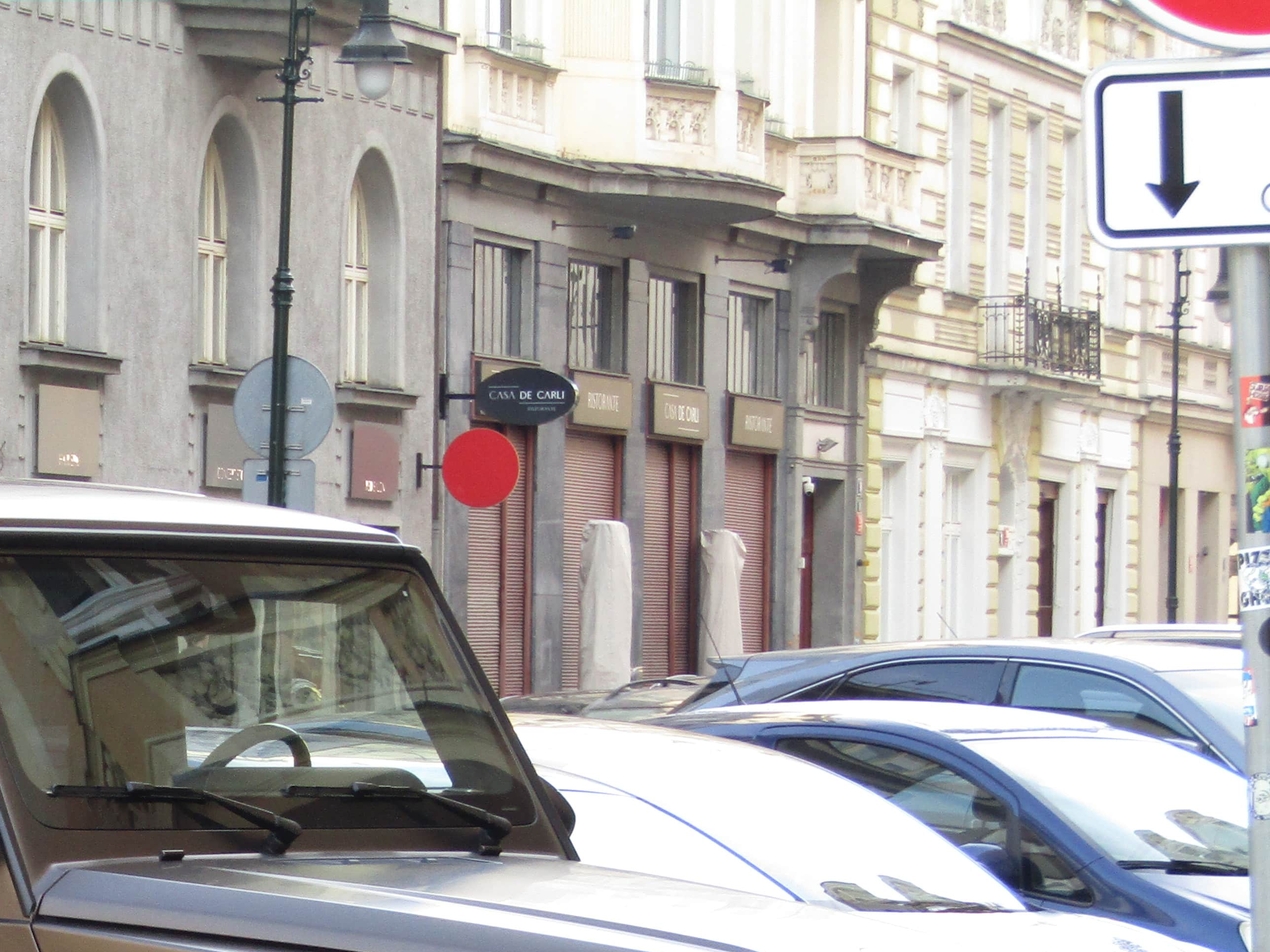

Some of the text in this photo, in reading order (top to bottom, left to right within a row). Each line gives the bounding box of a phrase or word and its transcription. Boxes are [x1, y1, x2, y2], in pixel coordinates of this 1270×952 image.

[488, 390, 565, 400] CASA DE CARLI
